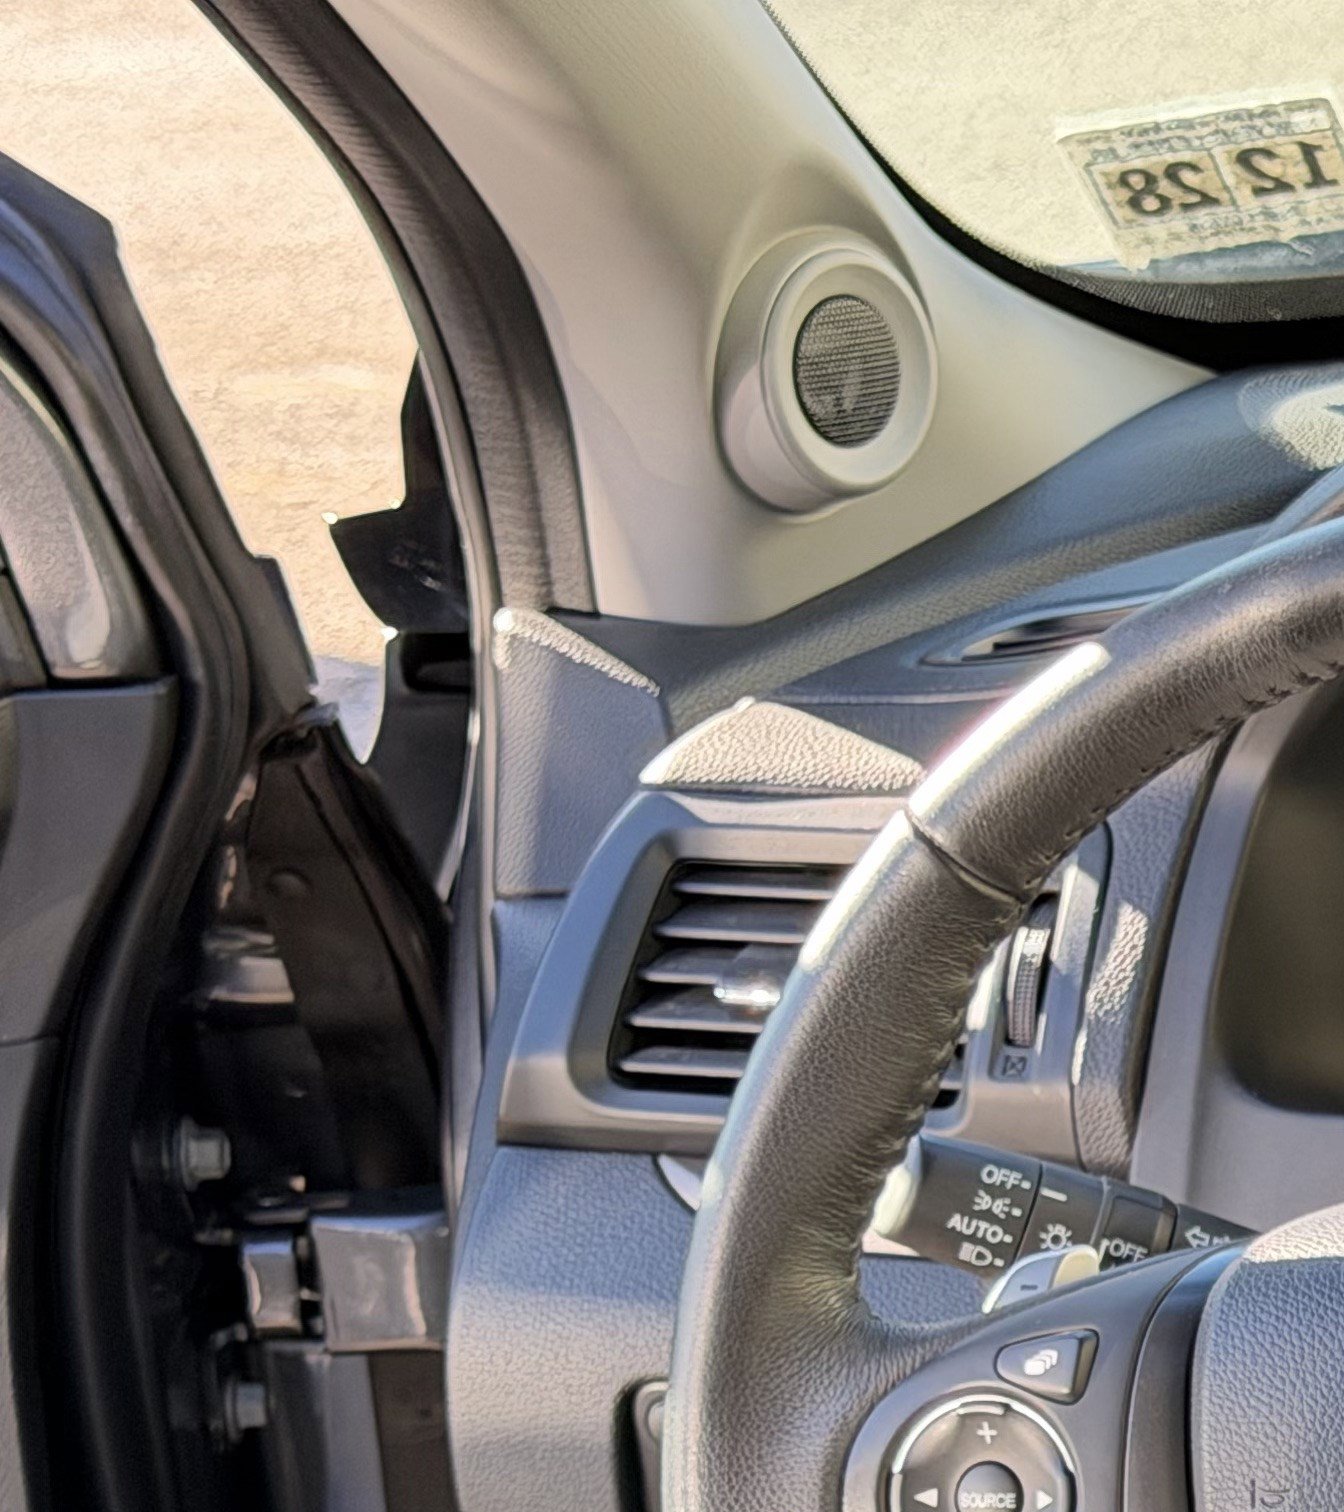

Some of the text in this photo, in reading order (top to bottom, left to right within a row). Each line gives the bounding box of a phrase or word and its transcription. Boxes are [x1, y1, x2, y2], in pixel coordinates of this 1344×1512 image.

[980, 1164, 1022, 1190] OFF
[946, 1212, 1004, 1244] AUTO
[1109, 1237, 1149, 1262] OFF
[960, 1491, 1017, 1509] SOURCE
